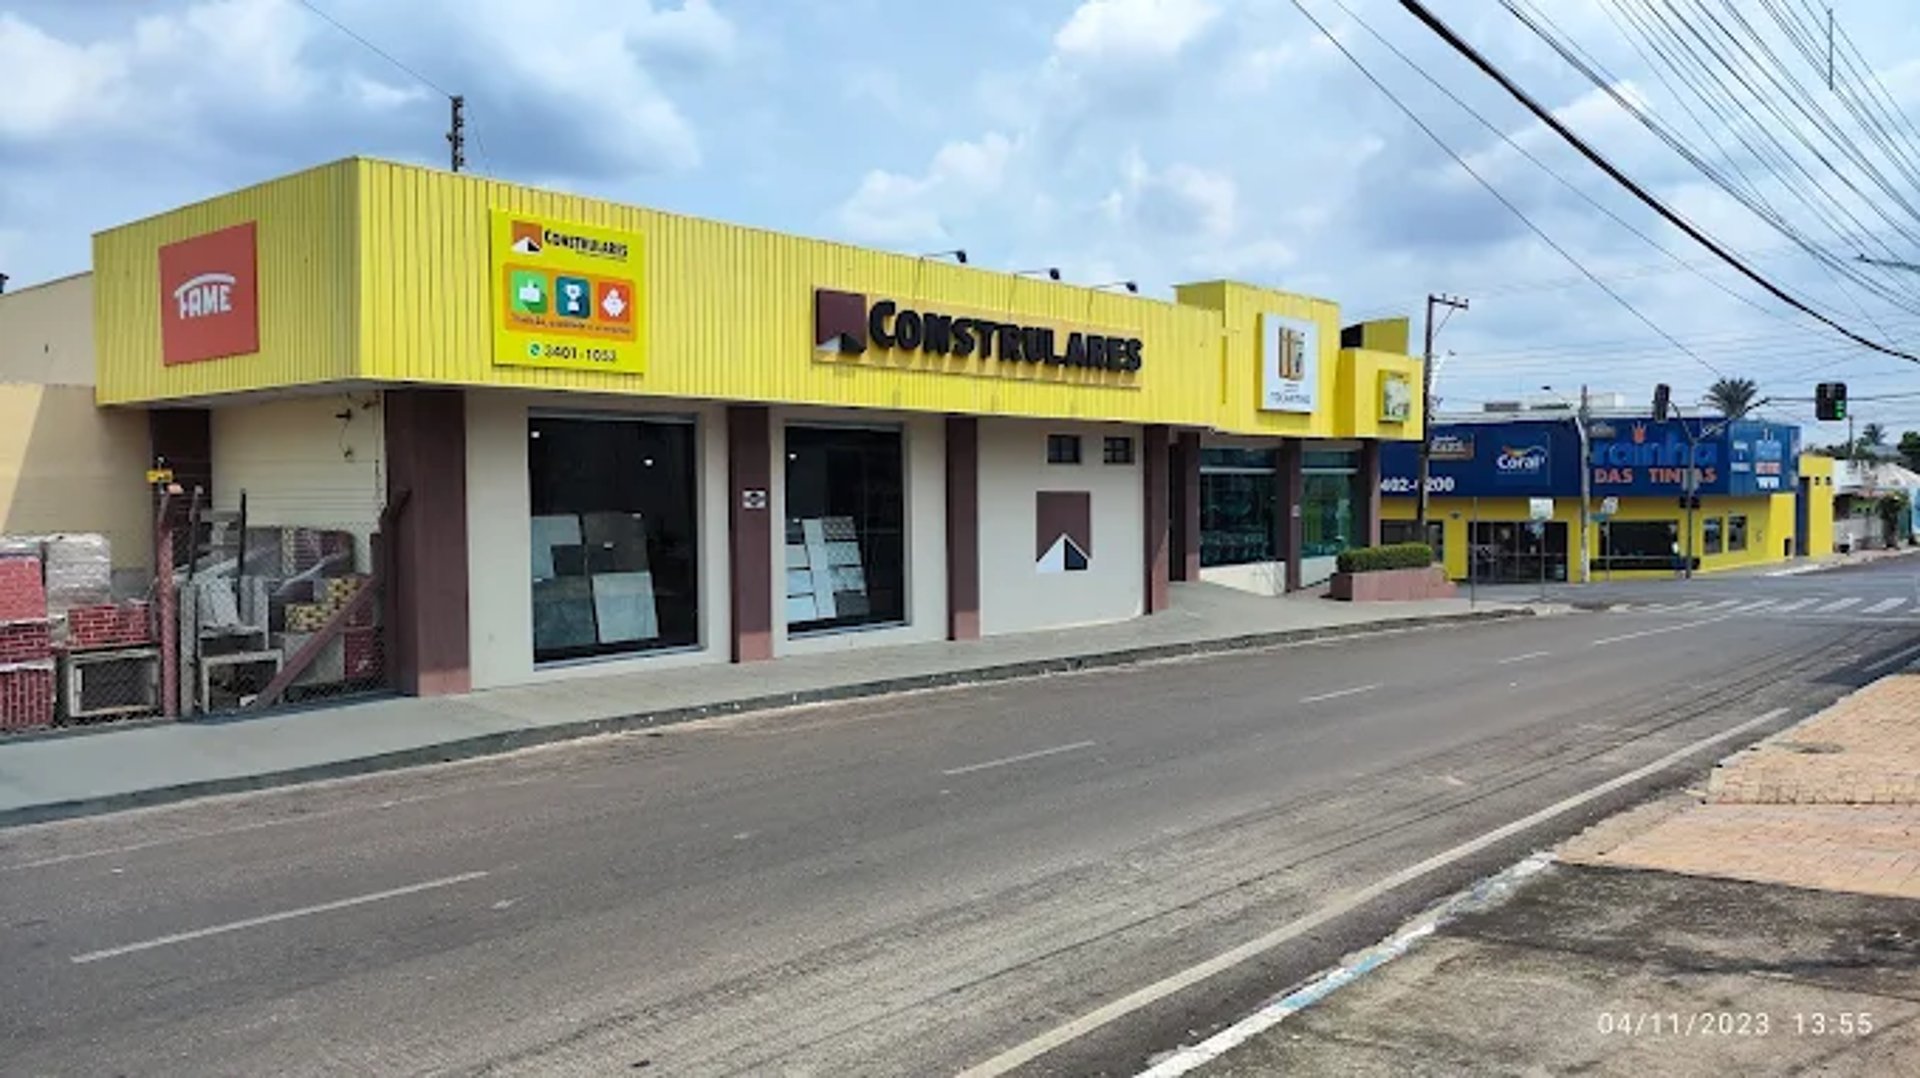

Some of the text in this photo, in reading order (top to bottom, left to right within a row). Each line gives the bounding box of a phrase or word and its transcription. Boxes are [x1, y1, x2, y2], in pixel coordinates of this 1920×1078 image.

[174, 273, 235, 319] FAME
[868, 300, 1143, 372] CONSTRULARES
[1497, 455, 1540, 470] Coral
[1380, 476, 1455, 492] 402-200
[1595, 468, 1717, 484] DAS TINAS
